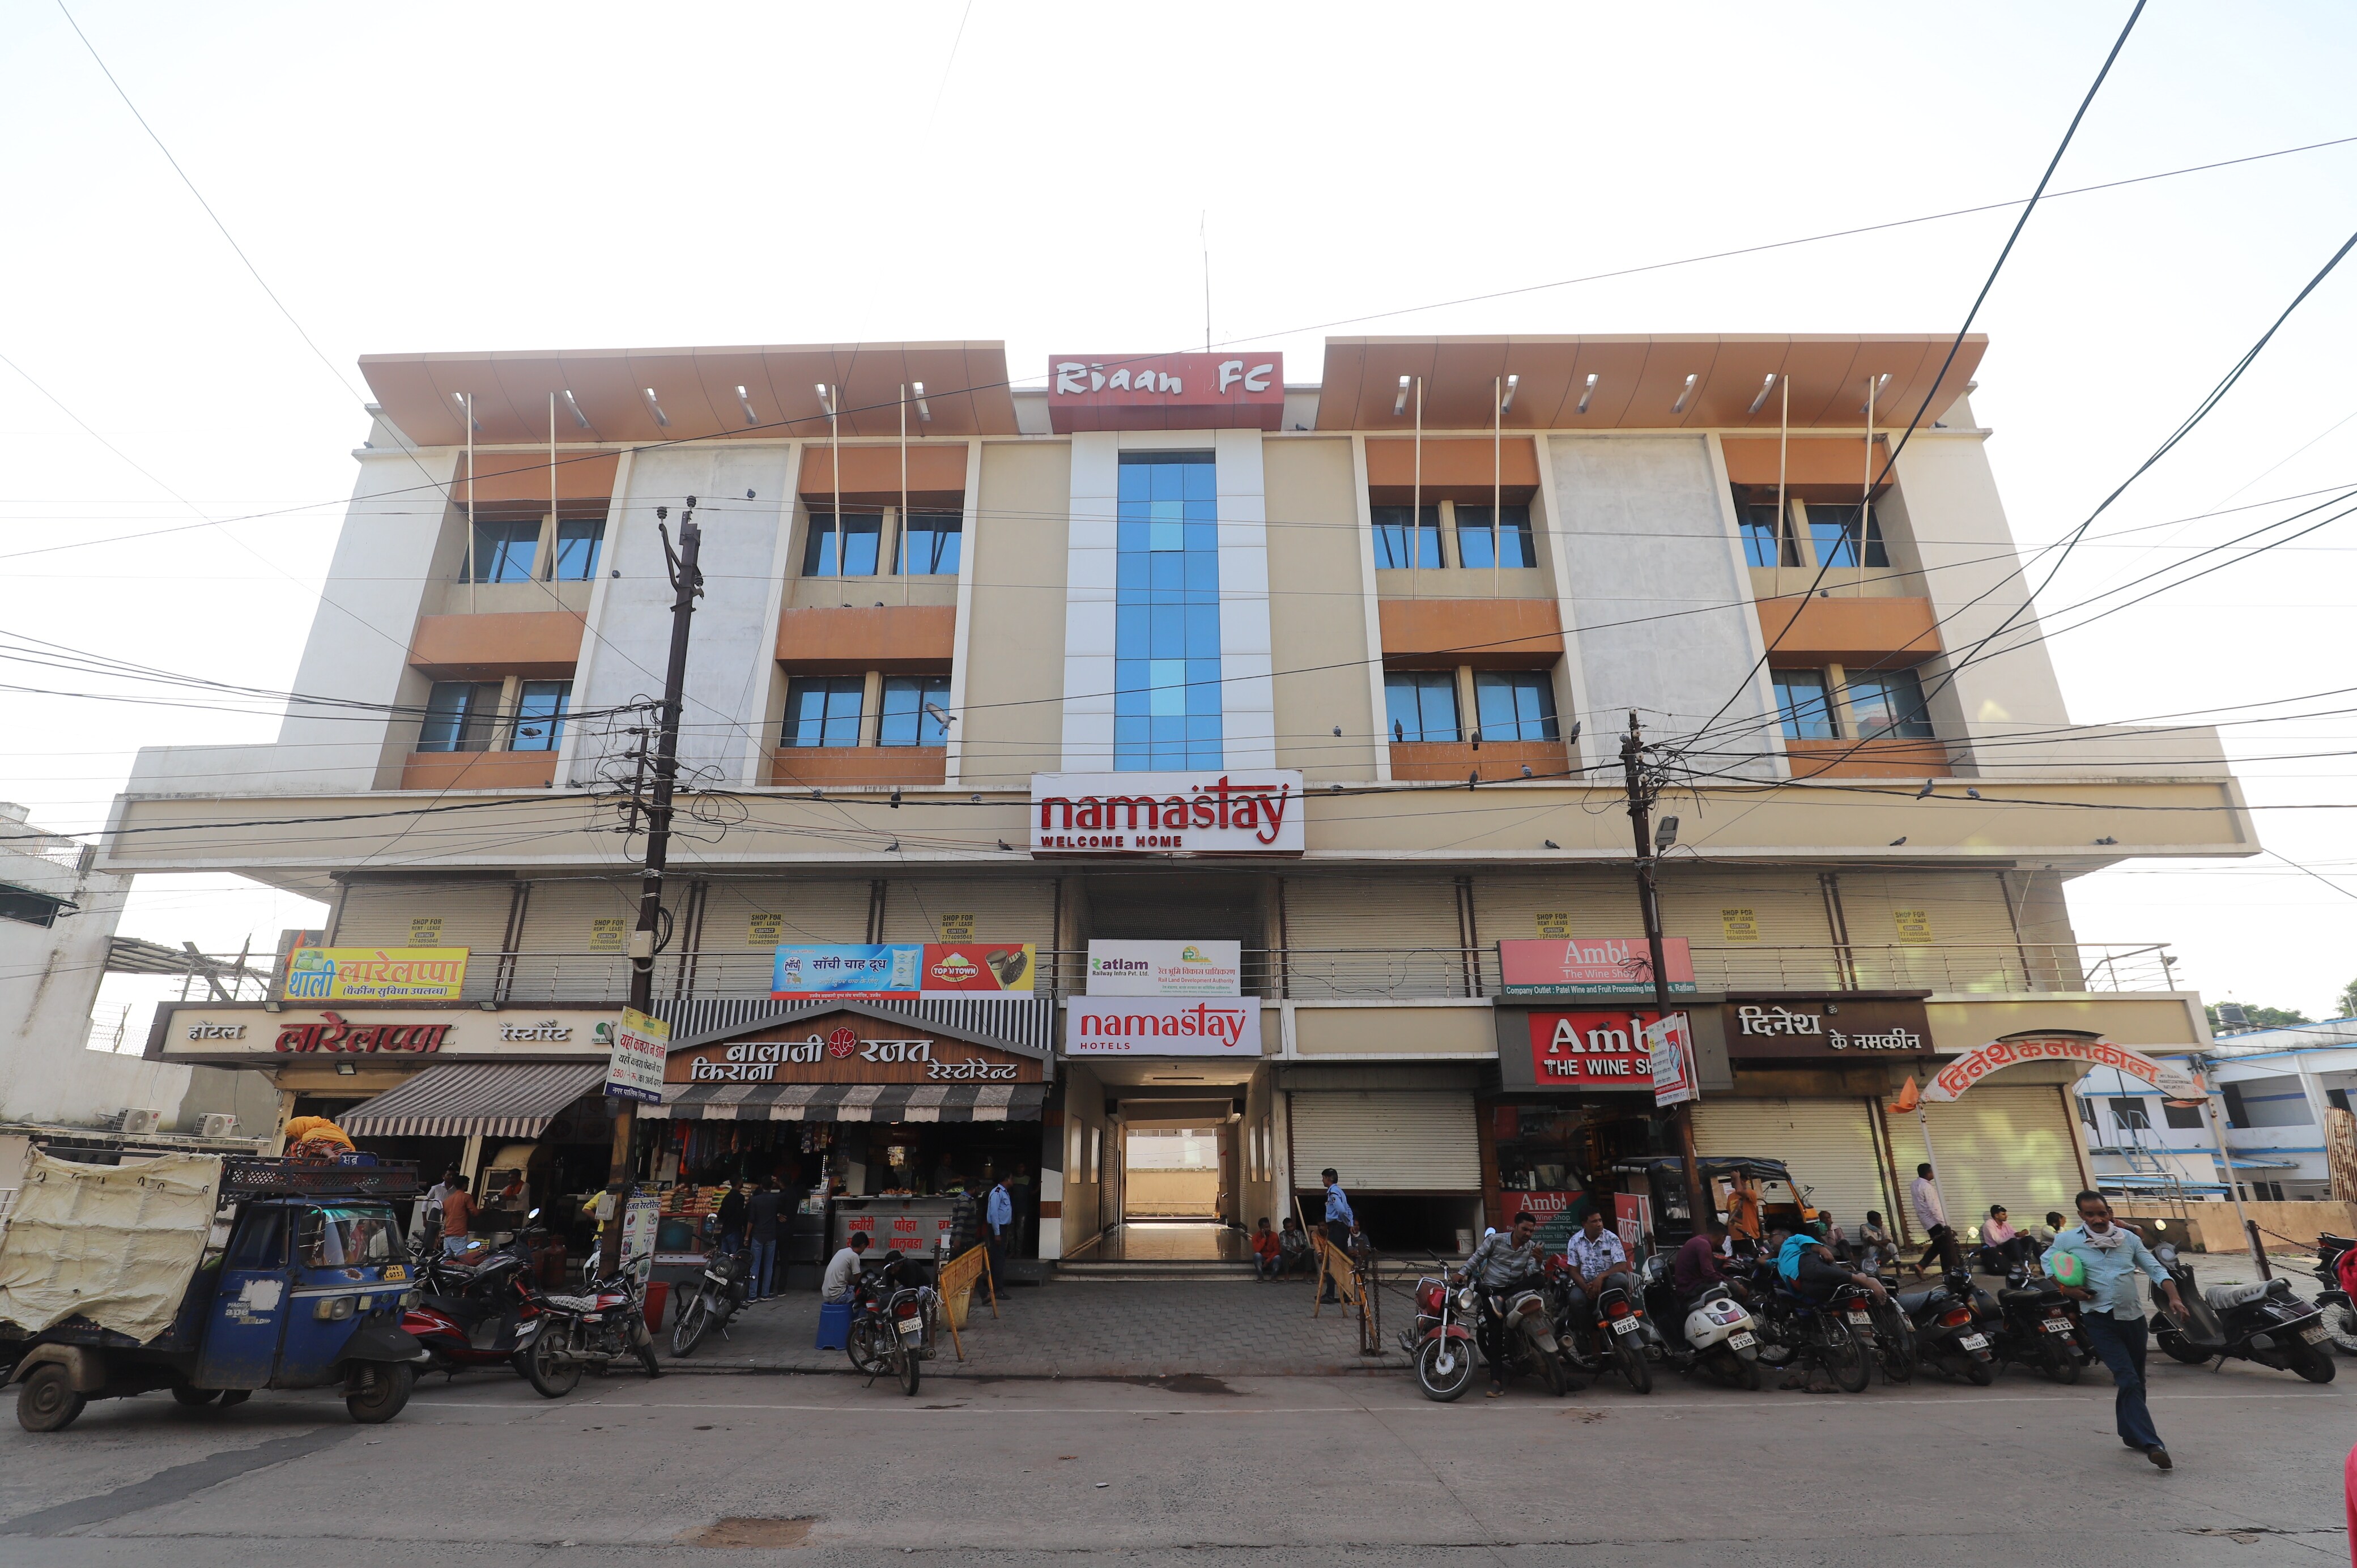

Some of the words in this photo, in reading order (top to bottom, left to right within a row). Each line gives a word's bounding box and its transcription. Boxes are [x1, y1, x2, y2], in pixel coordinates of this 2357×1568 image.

[1056, 363, 1182, 396] Riaan
[1218, 360, 1274, 394] FC
[1041, 775, 1289, 844] namastay
[1041, 836, 1124, 847] WELCOME
[1136, 836, 1182, 847] HOME
[338, 951, 462, 983] लारेलप्पा
[844, 959, 865, 970] चाह
[869, 959, 887, 973] दूध
[1092, 958, 1148, 970] Ratlam
[1168, 966, 1181, 977] भूमि
[1182, 966, 1203, 975] विकास
[1205, 966, 1235, 975] प्राधिकरण
[289, 960, 335, 997] थाली
[1563, 969, 1582, 978] The
[1585, 969, 1610, 978] Wine
[1612, 969, 1636, 981] Shop
[377, 986, 408, 997] सुविधा
[1506, 986, 1533, 995] Company
[1612, 985, 1644, 995] Processing
[1675, 984, 1695, 992] Ratlam
[1081, 1002, 1246, 1047] namastay
[1738, 1005, 1822, 1037] दिनेश
[275, 1011, 452, 1053] लारेलप्पा
[1549, 1018, 1650, 1054] Amb
[1830, 1029, 1848, 1050] के
[1853, 1028, 1922, 1049] नमकीन
[620, 1031, 634, 1050] यहाँ
[634, 1038, 649, 1055] कचरा
[649, 1043, 655, 1056] न
[724, 1034, 825, 1063] बालाजी
[860, 1039, 934, 1062] रजत
[631, 1058, 643, 1068] कचरा
[656, 1065, 662, 1073] पर
[691, 1056, 778, 1081] किराना
[928, 1058, 1018, 1079] रेस्टोरेन्ट
[1544, 1059, 1580, 1075] THE
[1586, 1059, 1631, 1075] WINE
[1635, 1060, 1653, 1075] SH
[1938, 1043, 2018, 1097] दिनेश
[2017, 1039, 2042, 1059] के
[2044, 1038, 2162, 1083] नमकीन
[639, 1074, 644, 1083] का
[894, 1216, 917, 1233] पोहा
[225, 1309, 249, 1318] ape
[1618, 1322, 1637, 1333] 0885
[2049, 1322, 2070, 1331] 6147
[1734, 1338, 1752, 1348] 2130
[1967, 1340, 1986, 1349] 9805
